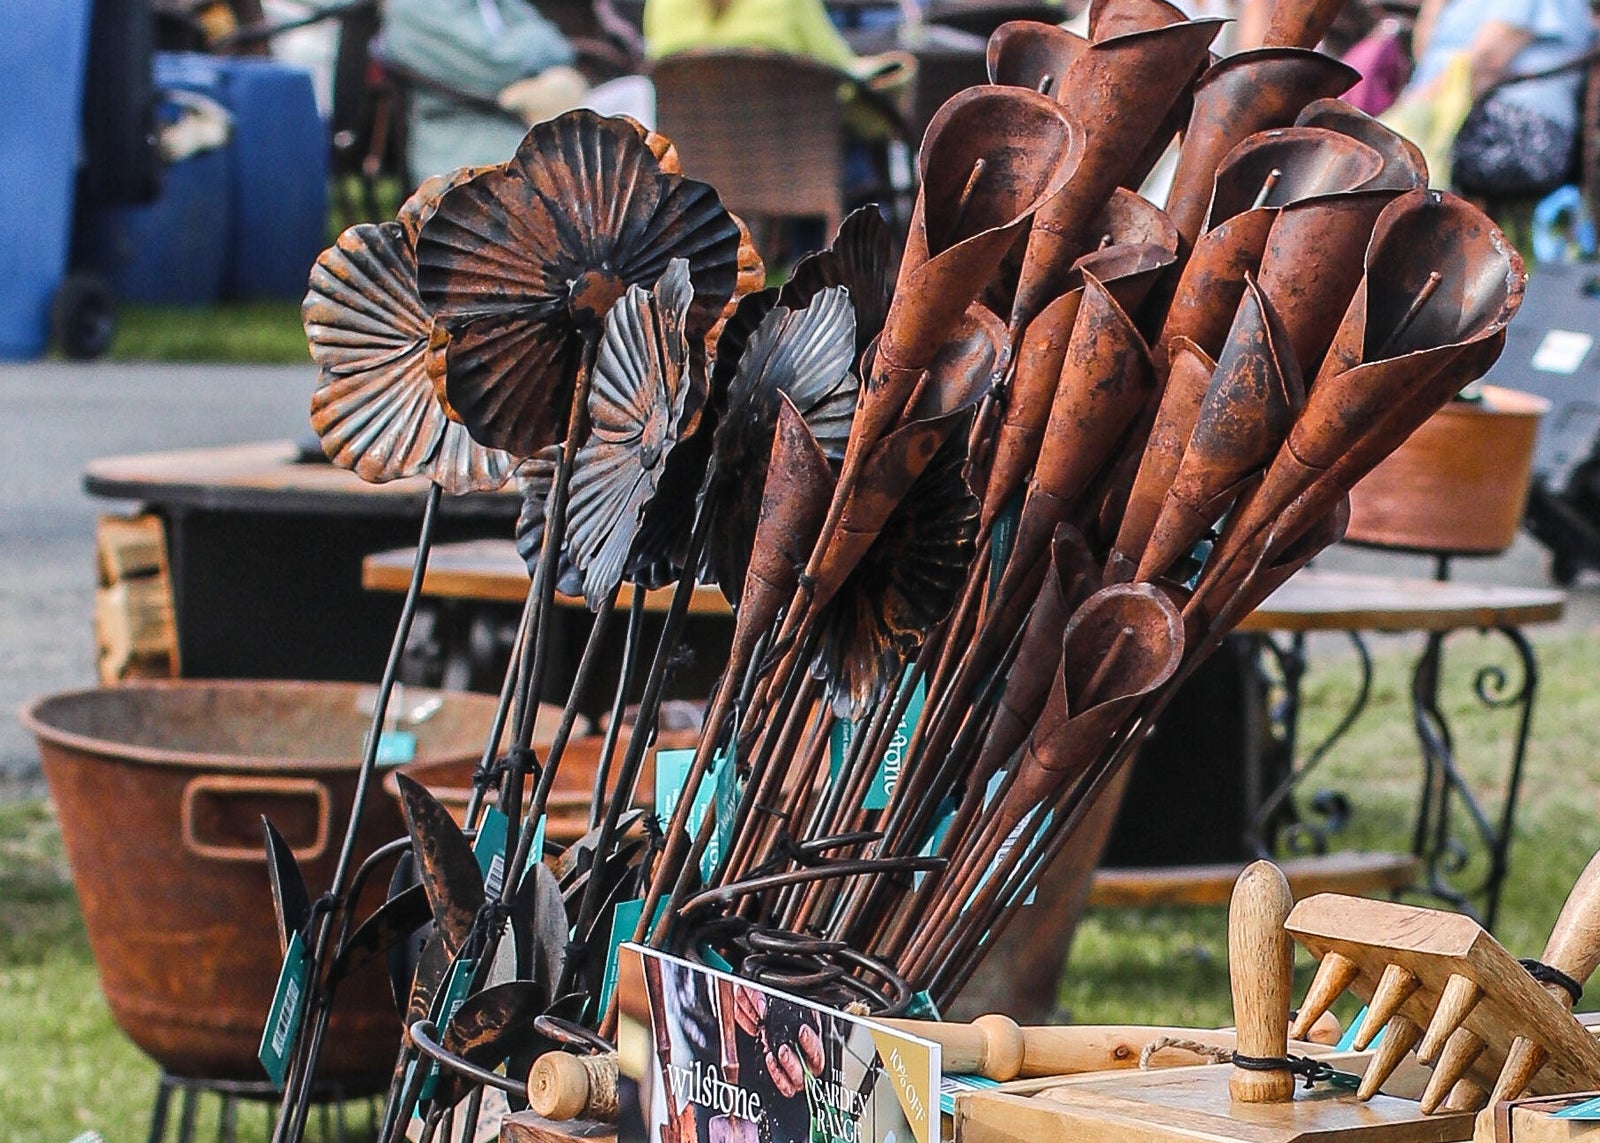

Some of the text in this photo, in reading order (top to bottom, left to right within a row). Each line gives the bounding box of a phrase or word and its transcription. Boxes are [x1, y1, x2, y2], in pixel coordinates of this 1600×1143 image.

[667, 1060, 762, 1124] wilstone
[812, 1078, 869, 1118] GARDEN
[832, 1068, 846, 1084] THE
[890, 1048, 926, 1121] 10% OFF
